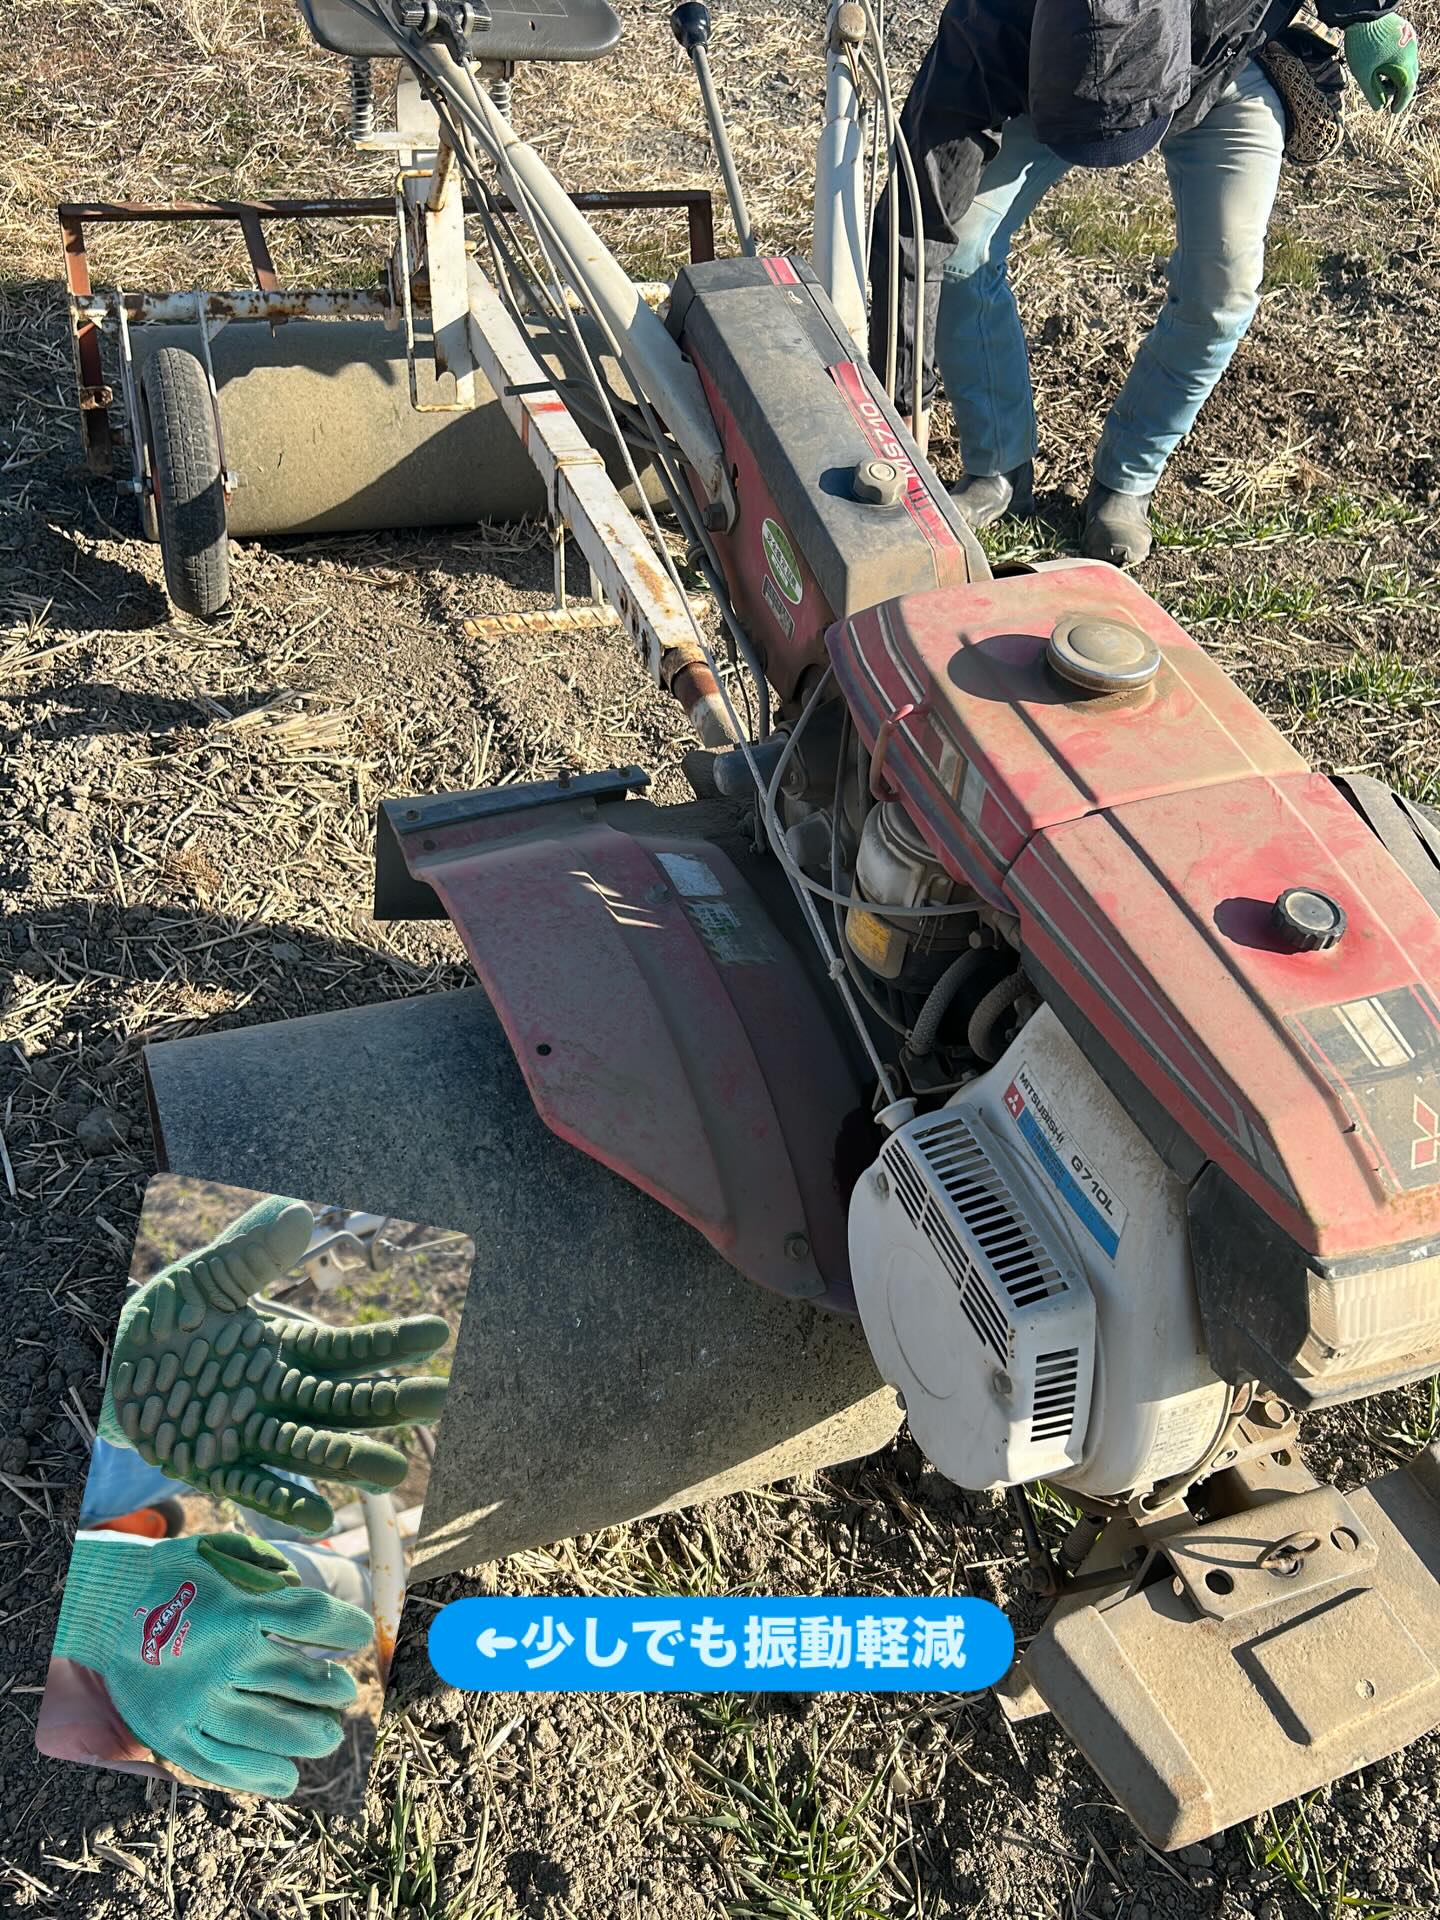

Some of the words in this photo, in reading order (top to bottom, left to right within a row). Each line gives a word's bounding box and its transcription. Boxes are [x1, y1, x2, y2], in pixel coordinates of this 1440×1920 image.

[1019, 1072, 1064, 1144] MITSUBISHI
[1071, 1155, 1113, 1216] G710L
[171, 1620, 190, 1656] ATOM
